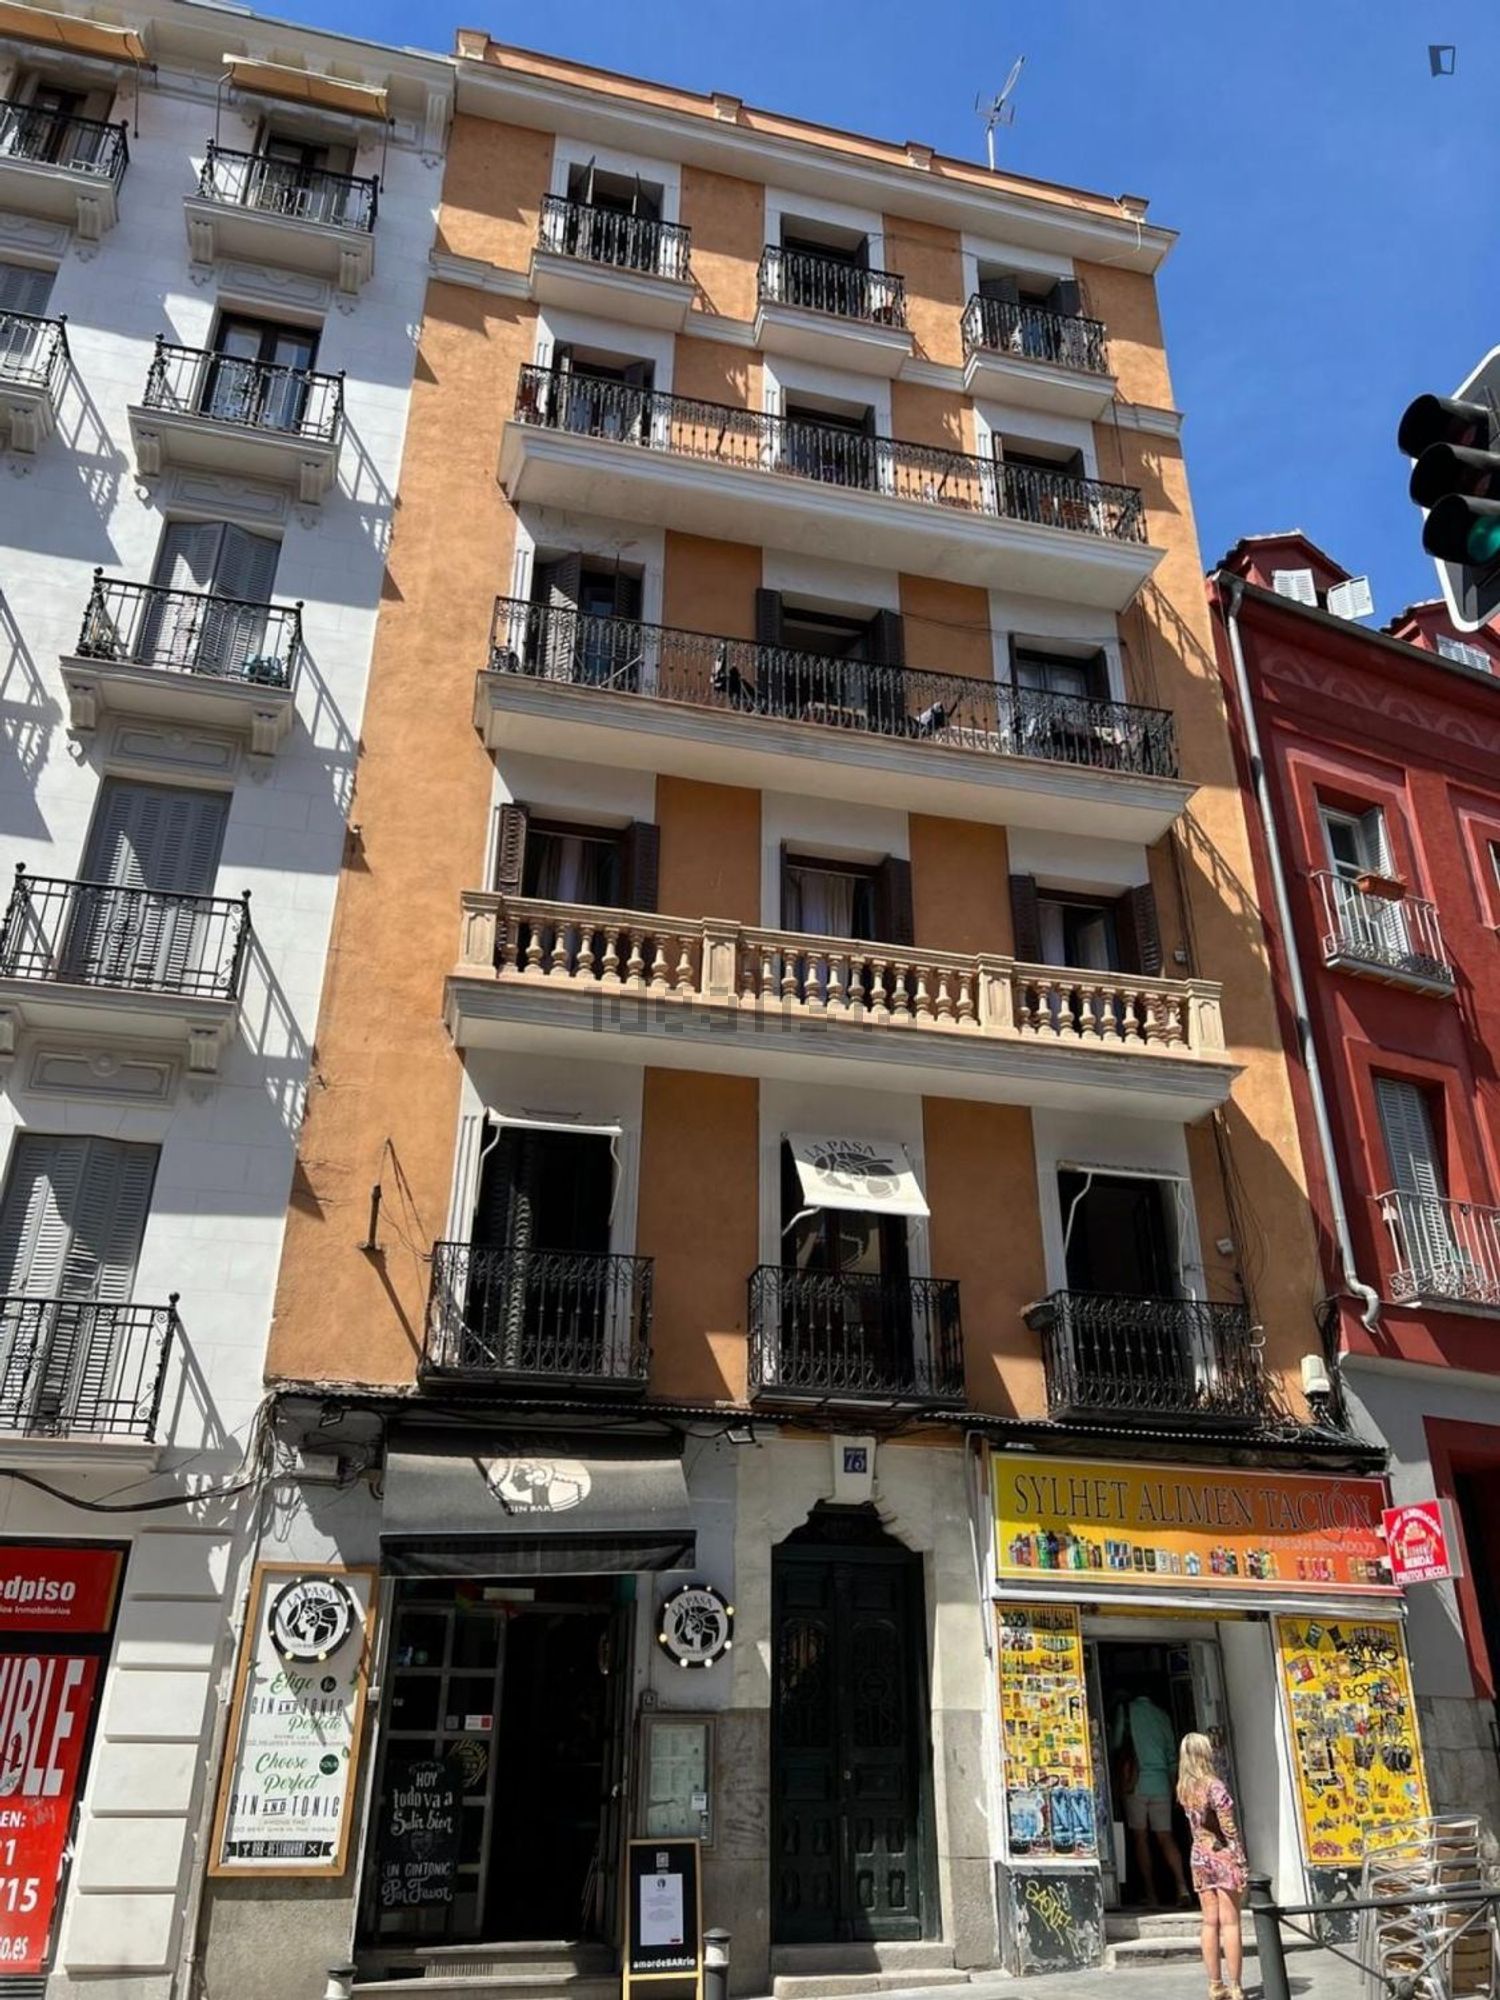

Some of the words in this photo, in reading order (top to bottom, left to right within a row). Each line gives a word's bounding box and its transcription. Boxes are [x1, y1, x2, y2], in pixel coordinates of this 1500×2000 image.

[804, 1143, 827, 1160] LA
[827, 1140, 876, 1157] PASA
[1014, 1474, 1128, 1520] SYLHET
[0, 1576, 76, 1602] dpiso
[286, 1592, 302, 1608] LA
[303, 1586, 334, 1600] PASA
[671, 1602, 685, 1617] LA
[686, 1595, 713, 1608] PASA
[251, 1696, 276, 1715] GIN
[302, 1698, 344, 1716] TONIC
[255, 1752, 309, 1774] Choose
[263, 1773, 320, 1796] Perfect
[415, 1771, 438, 1788] HOY
[230, 1794, 259, 1816] GIN
[292, 1795, 341, 1818] TONIC
